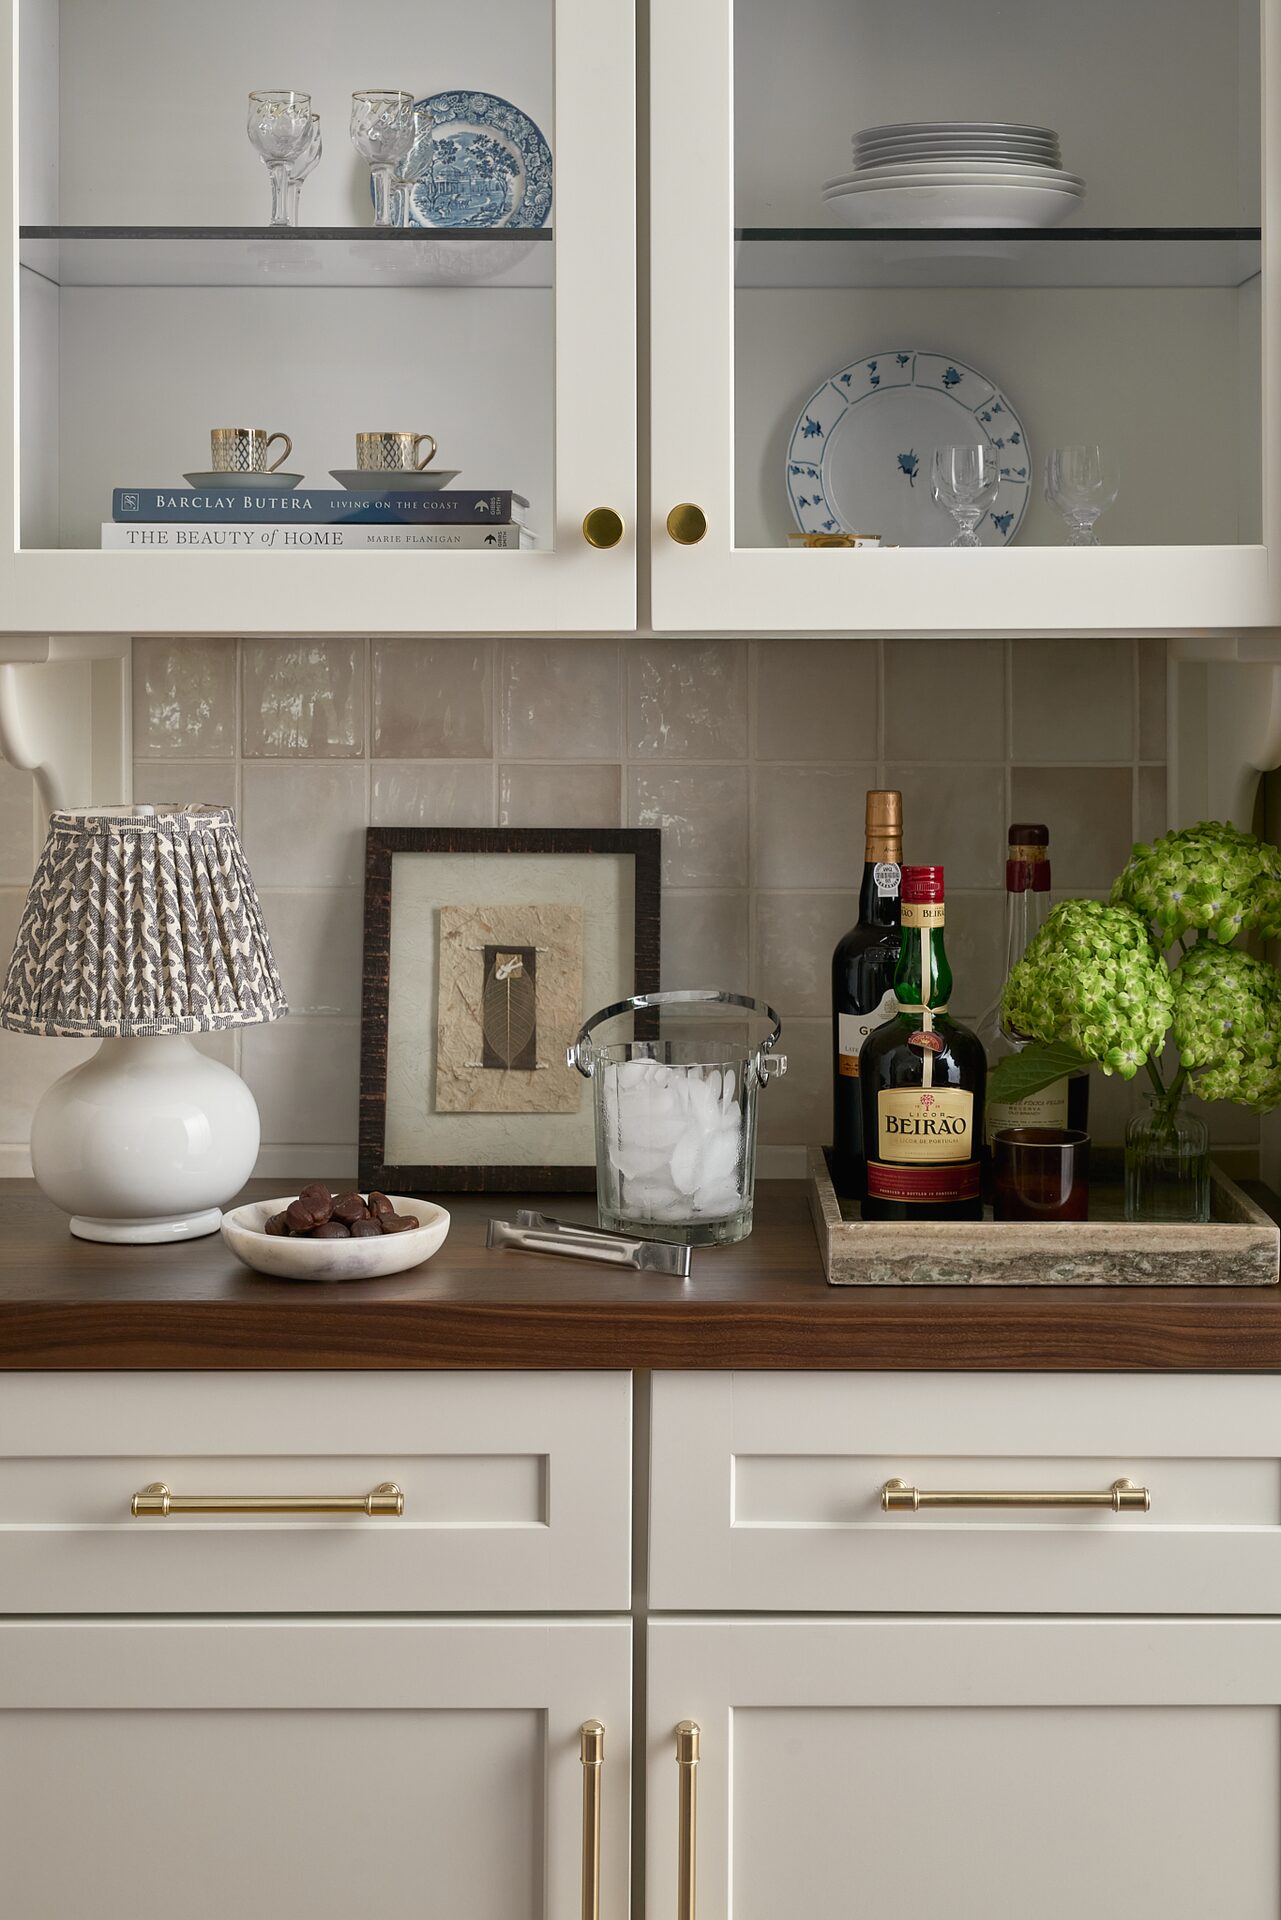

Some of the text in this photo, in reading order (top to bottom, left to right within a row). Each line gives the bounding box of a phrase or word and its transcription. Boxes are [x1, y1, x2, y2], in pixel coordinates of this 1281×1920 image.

[156, 495, 313, 509] BARCLAY BUTERA
[330, 501, 370, 509] LIVING
[375, 501, 391, 509] ON
[423, 502, 459, 510] COAST
[126, 529, 343, 547] THE BEAUTY of HOME
[367, 535, 461, 543] MARIE FLANIGAN
[885, 1115, 966, 1135] BEIRÃO
